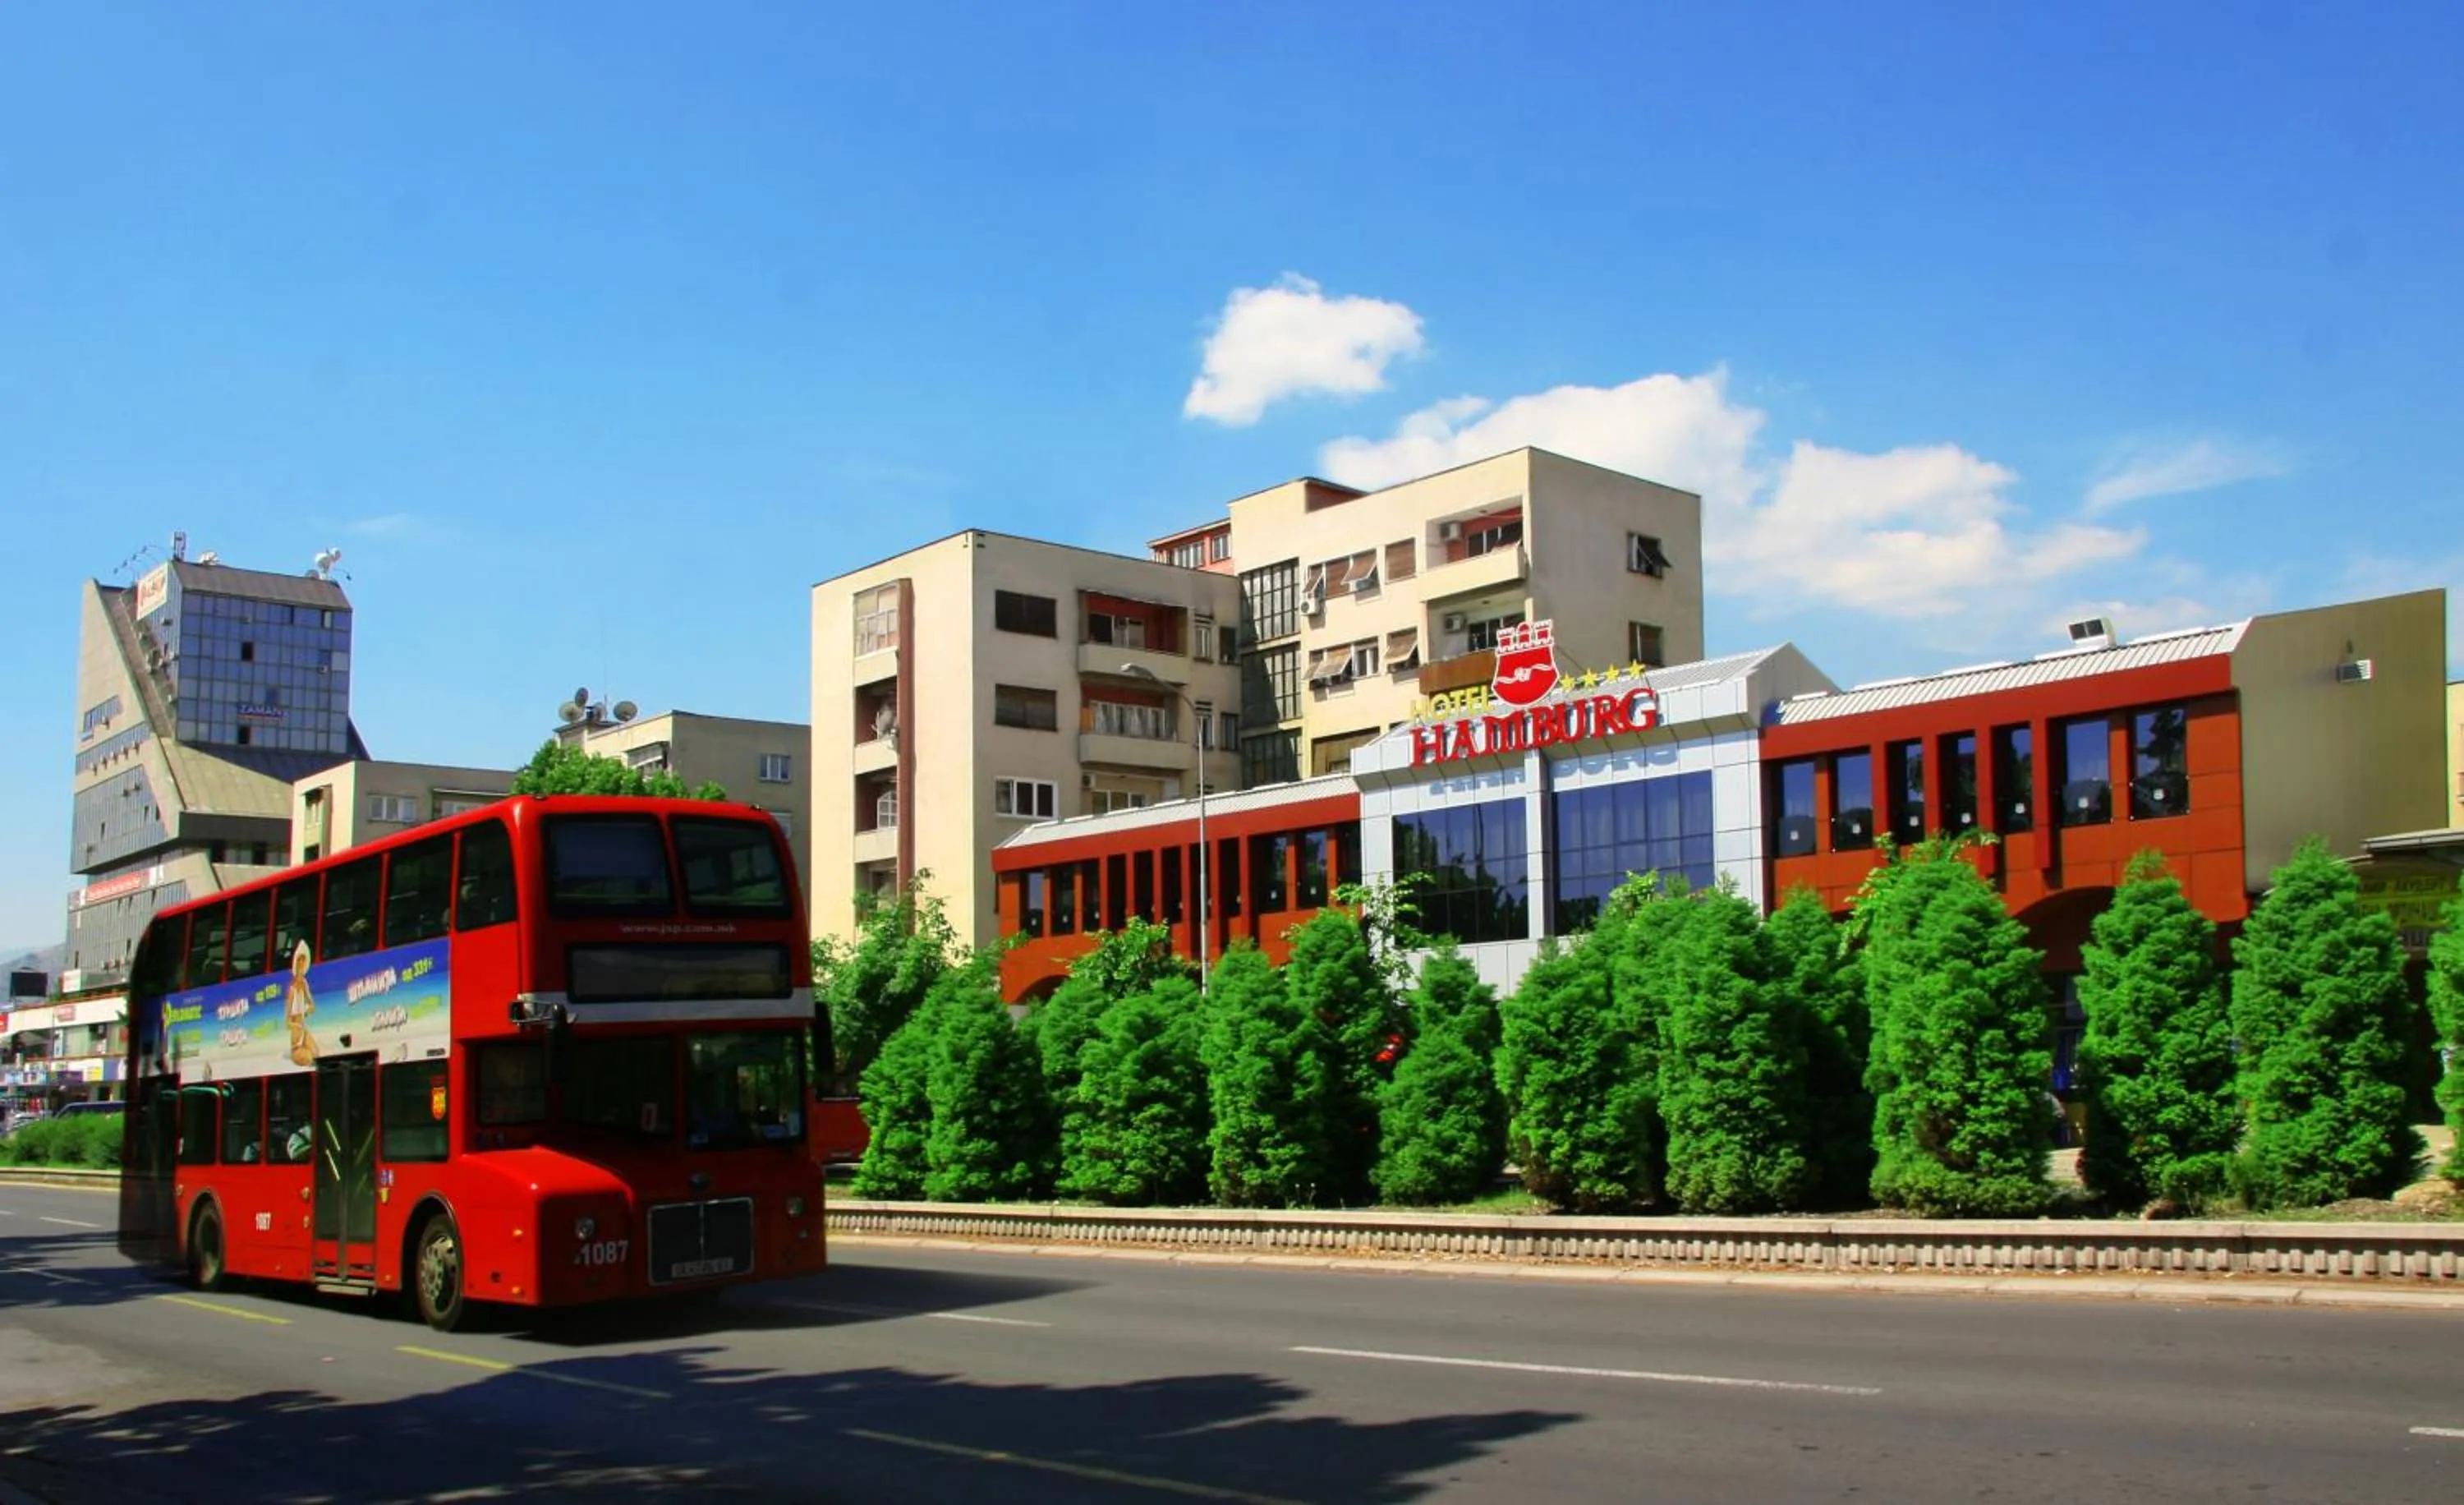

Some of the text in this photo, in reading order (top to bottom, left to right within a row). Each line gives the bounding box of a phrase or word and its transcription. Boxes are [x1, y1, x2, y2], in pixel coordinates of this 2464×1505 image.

[1409, 684, 1495, 722] HOTEL
[1409, 687, 1658, 768] HAMBURG
[581, 1240, 629, 1266] 1087
